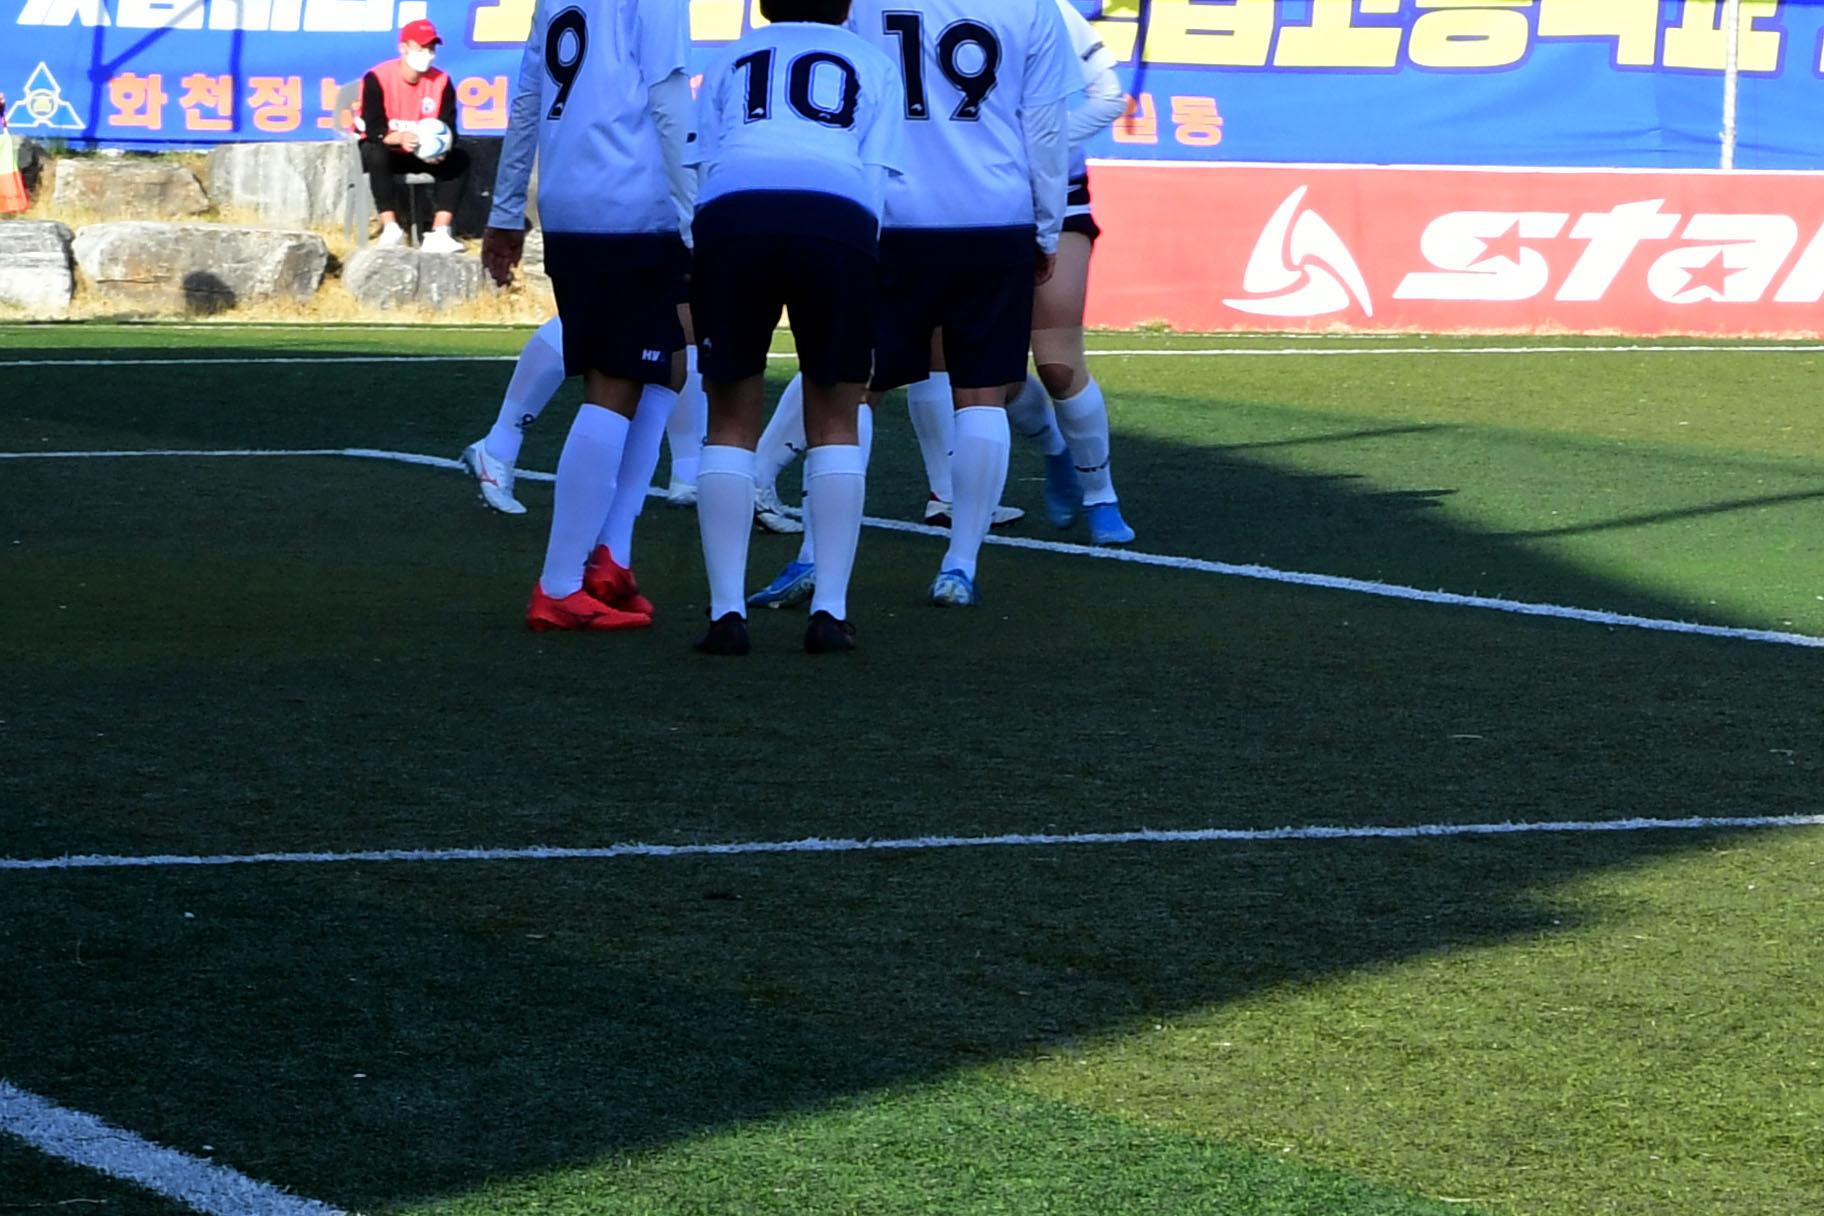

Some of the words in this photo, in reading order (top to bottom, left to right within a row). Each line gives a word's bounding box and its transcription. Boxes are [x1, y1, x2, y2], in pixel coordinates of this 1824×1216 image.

[545, 5, 589, 120] 9
[731, 45, 864, 129] 10
[881, 9, 1003, 122] 19
